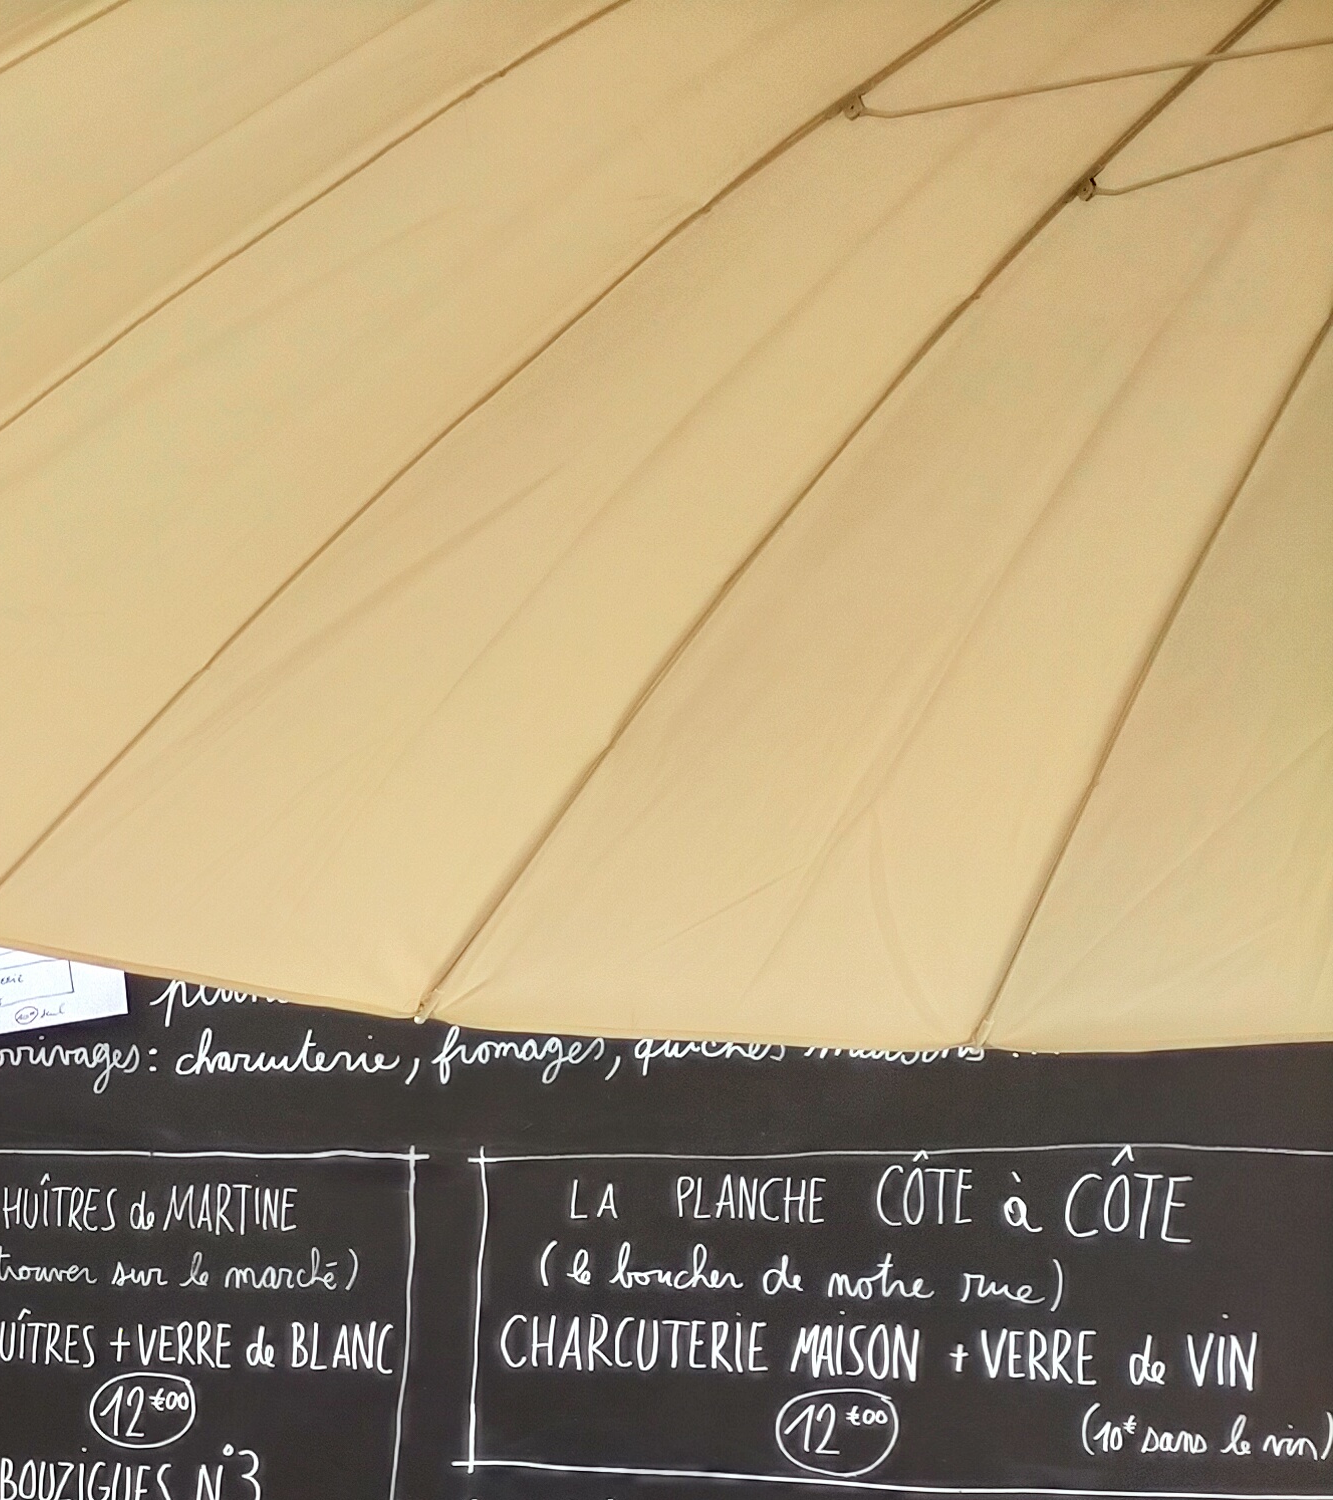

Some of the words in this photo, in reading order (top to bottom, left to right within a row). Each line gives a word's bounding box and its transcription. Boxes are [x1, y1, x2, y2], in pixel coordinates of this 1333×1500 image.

[2, 1172, 117, 1234] HUÎTRES
[162, 1183, 299, 1236] MARTINE
[567, 1179, 621, 1223] LA
[677, 1173, 828, 1226] PLANCHE
[875, 1148, 976, 1228] CÔTE
[1004, 1170, 1045, 1235] à
[1063, 1143, 1195, 1245] CÔTE
[608, 1244, 748, 1292] boucher
[762, 1249, 806, 1293] de
[825, 1257, 936, 1302] notre
[244, 1323, 275, 1369] de
[290, 1319, 395, 1376] BLANC
[498, 1312, 770, 1375] CHARCUTERIE
[789, 1309, 923, 1384] MAISON
[1127, 1330, 1168, 1388] de
[1183, 1312, 1261, 1394] VIN
[1140, 1422, 1209, 1456] sans
[1220, 1414, 1253, 1458] le
